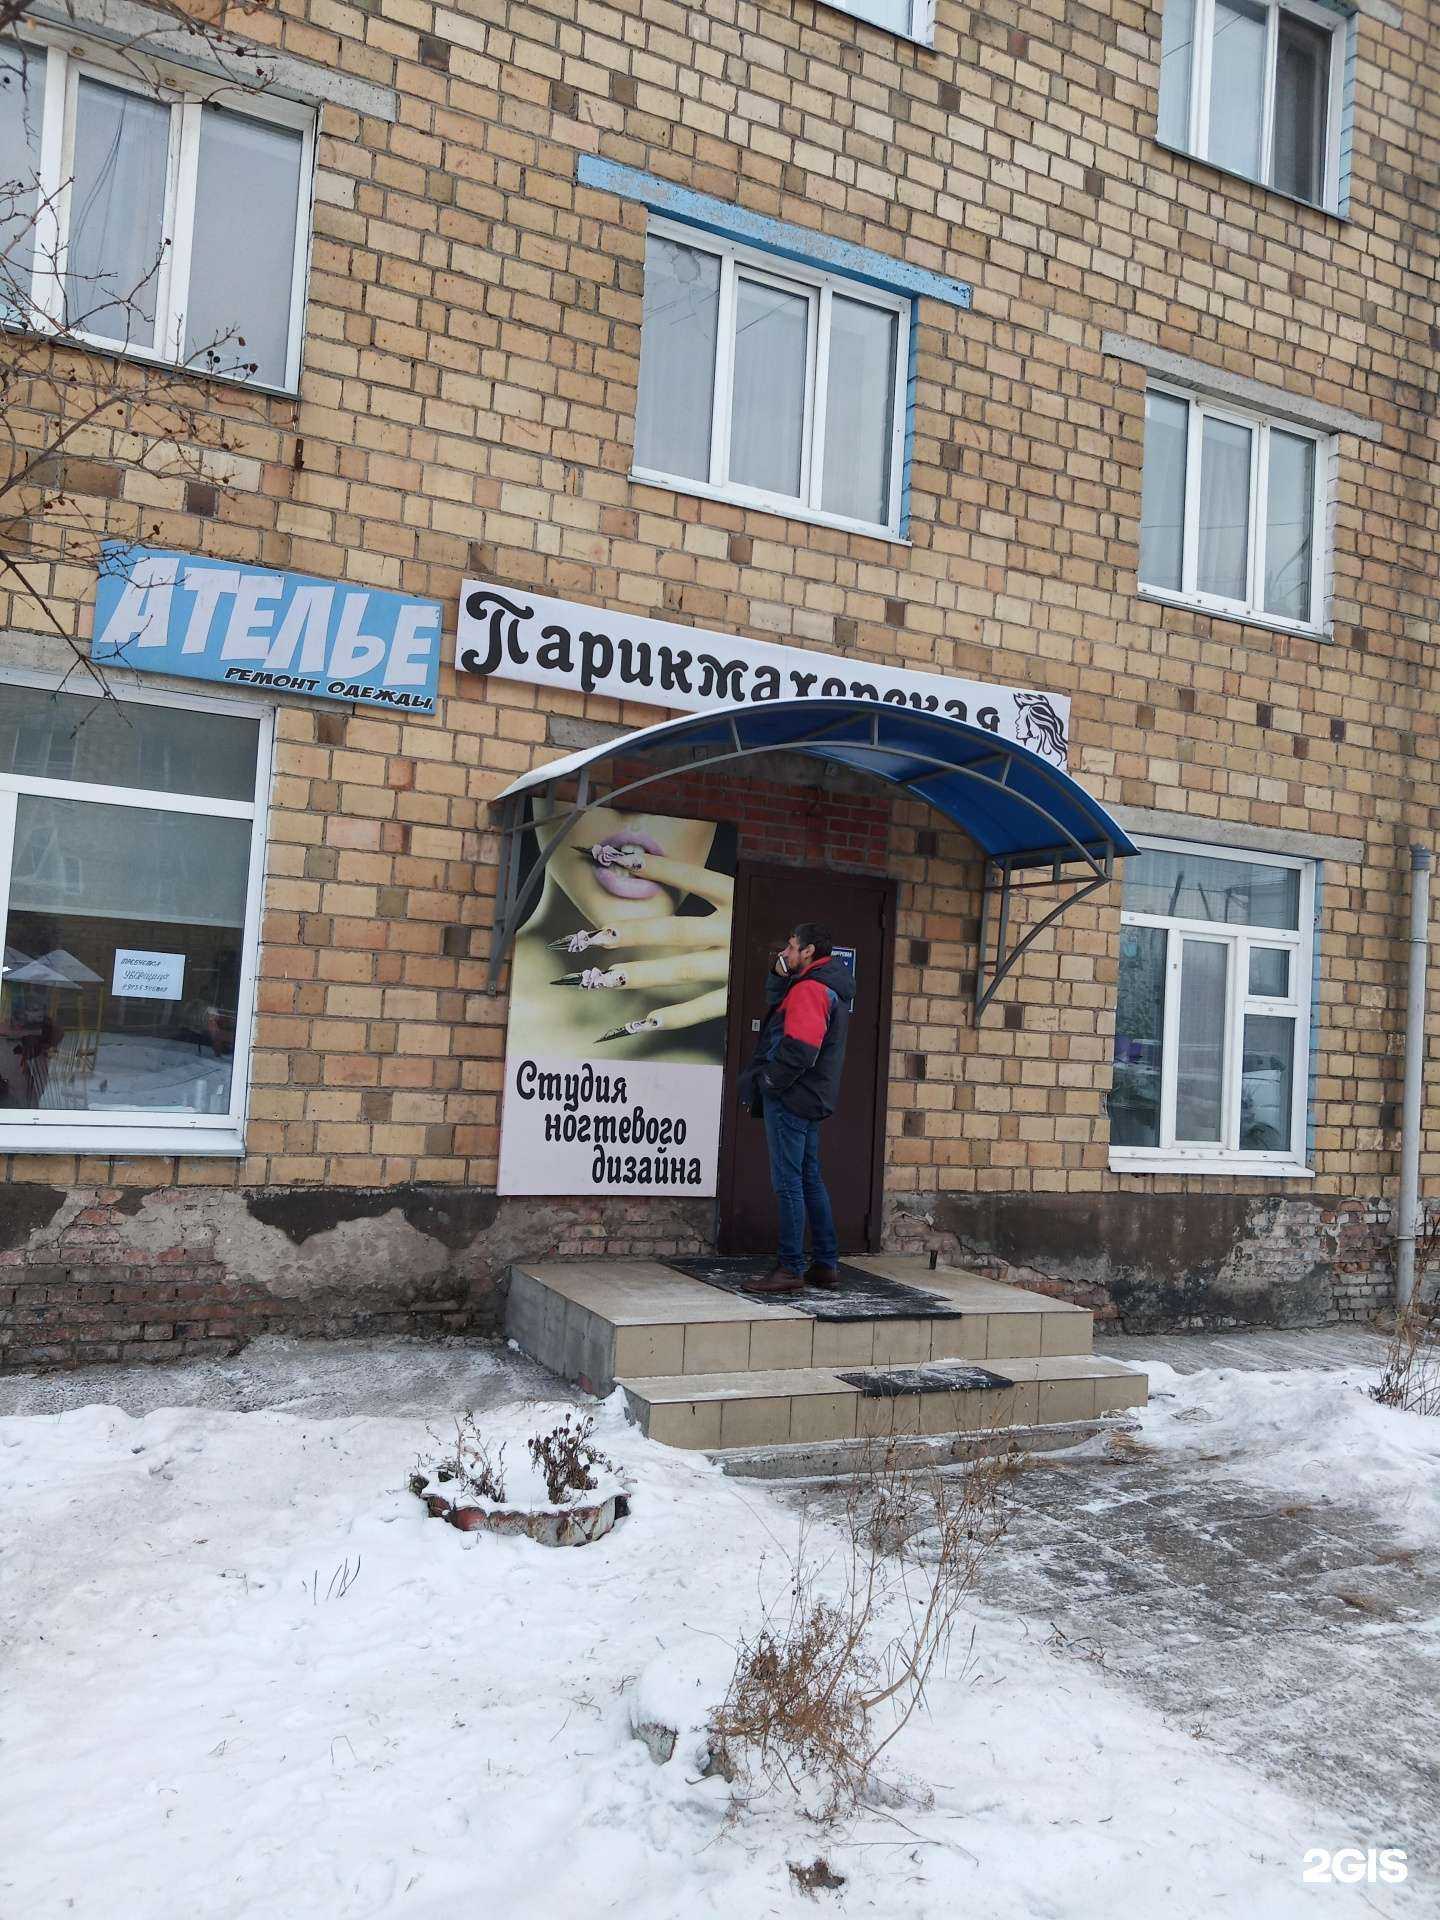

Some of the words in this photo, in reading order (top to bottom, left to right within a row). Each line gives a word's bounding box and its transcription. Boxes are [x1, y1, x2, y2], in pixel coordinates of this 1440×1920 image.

[99, 557, 442, 686] АТЕЛЬЕ
[224, 667, 320, 691] РЕМОНТ
[327, 681, 433, 710] ОДЕЖДЫ
[516, 1060, 628, 1112] Студия
[544, 1106, 687, 1145] ногтевого
[592, 1144, 702, 1185] дизайна
